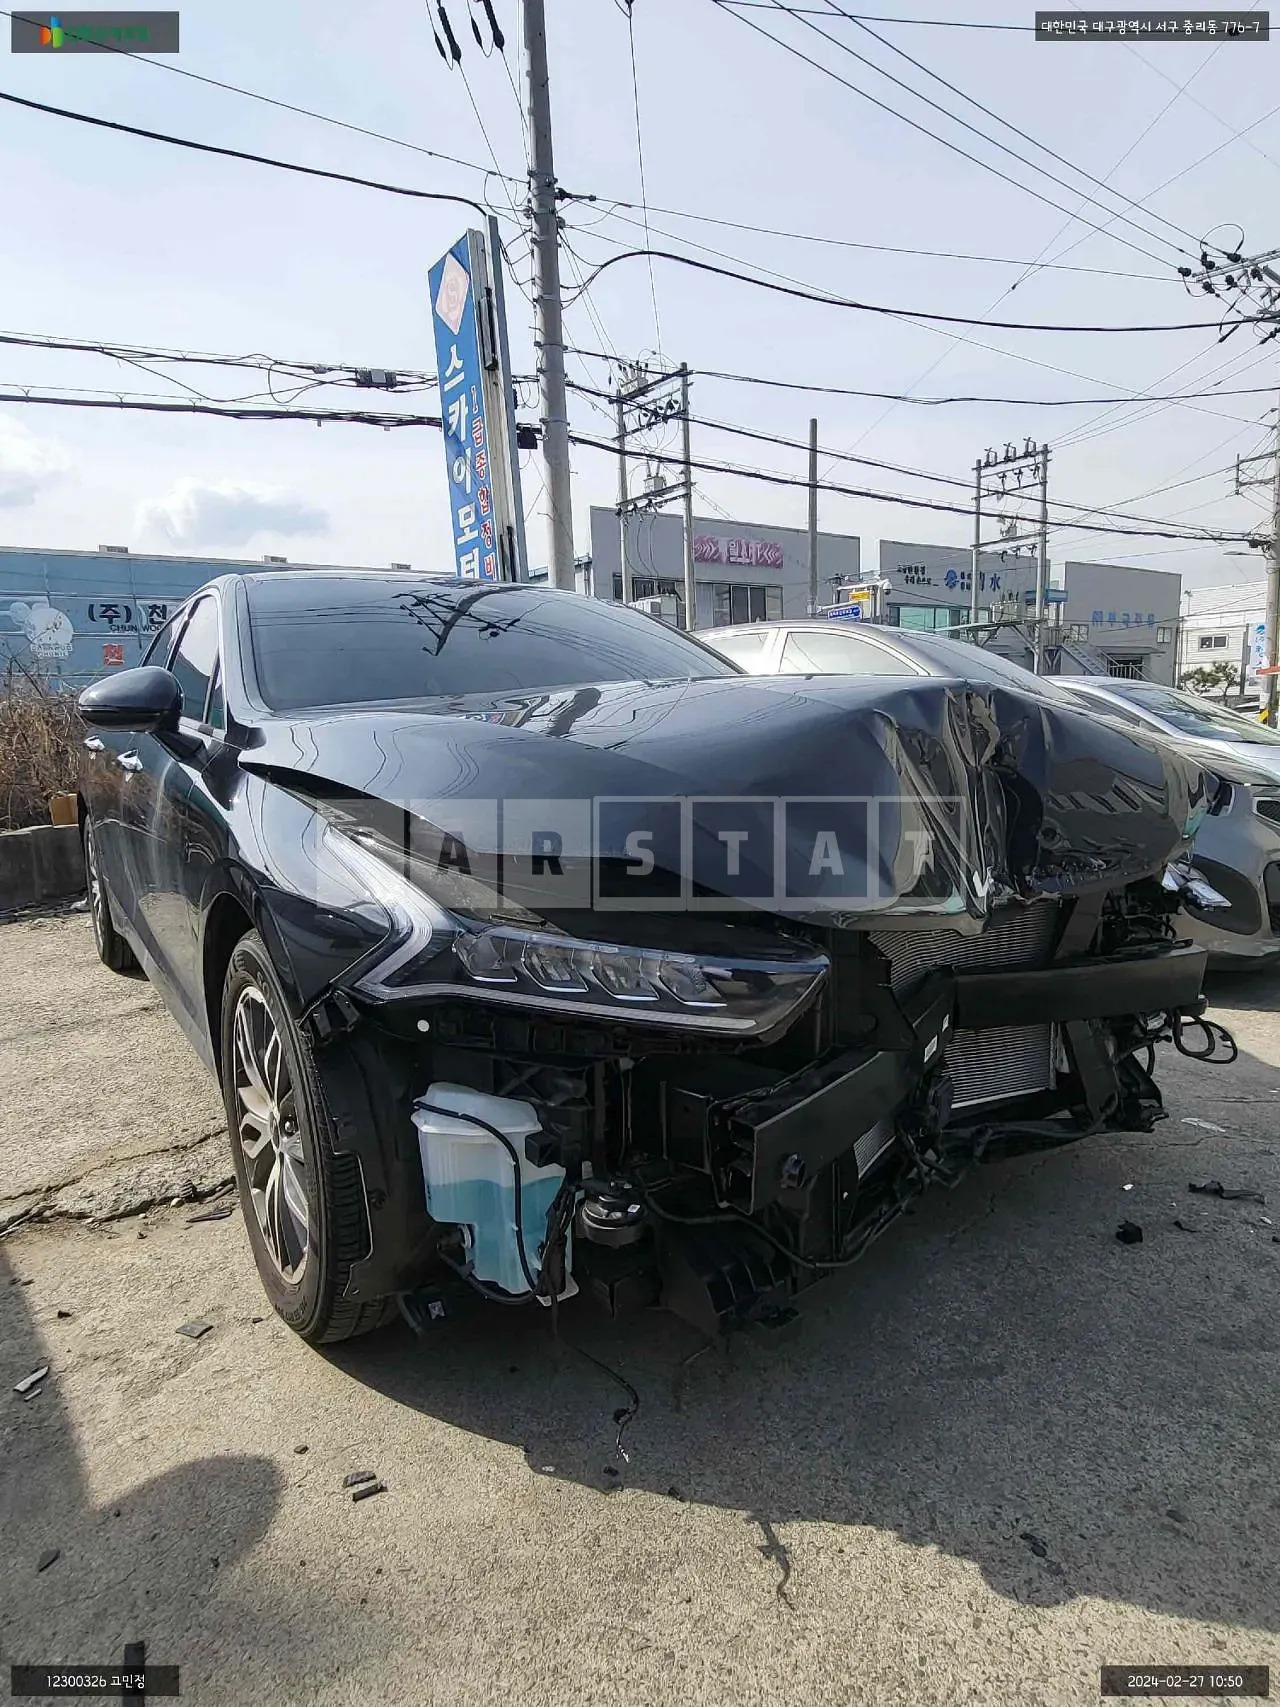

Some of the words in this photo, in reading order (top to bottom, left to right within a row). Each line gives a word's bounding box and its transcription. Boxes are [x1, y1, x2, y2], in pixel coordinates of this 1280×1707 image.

[444, 343, 481, 579] 스카이모터
[88, 603, 132, 624] (주)
[110, 624, 138, 632] CHUN
